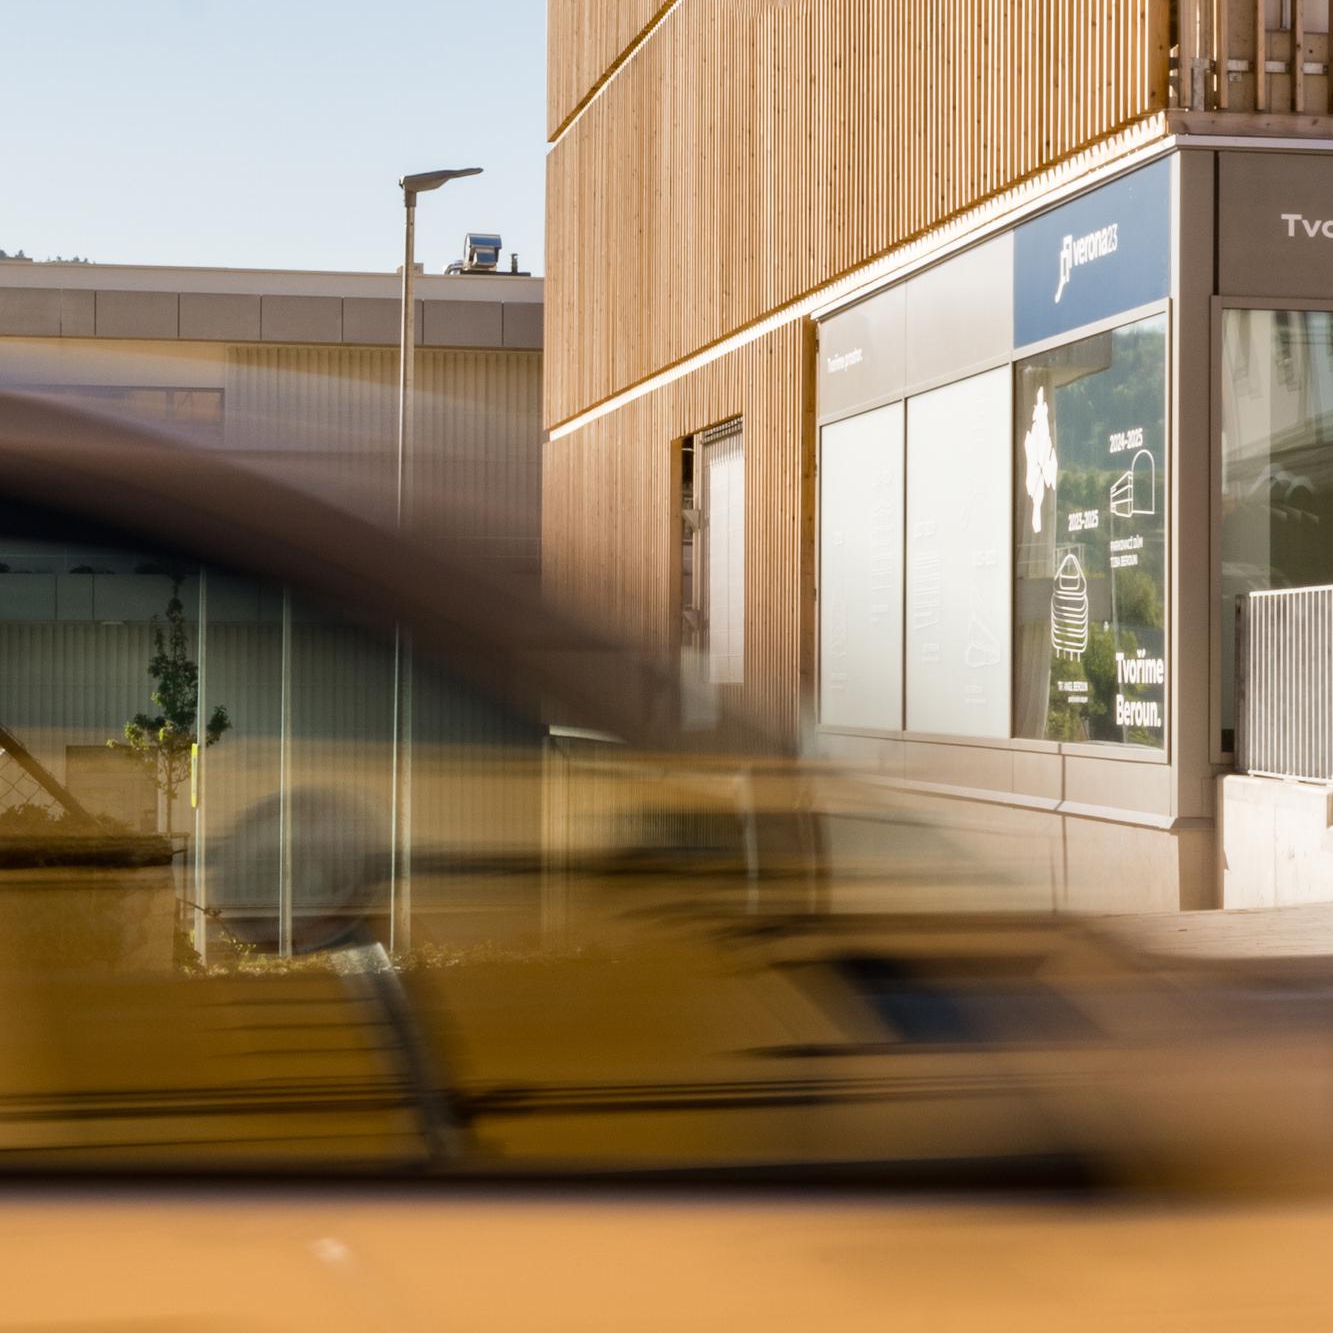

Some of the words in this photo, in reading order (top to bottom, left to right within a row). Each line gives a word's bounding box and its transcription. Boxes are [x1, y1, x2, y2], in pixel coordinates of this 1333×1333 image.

[1072, 223, 1119, 267] verona23
[1115, 648, 1164, 684] Tvoříme
[1115, 693, 1162, 728] Beroun.
